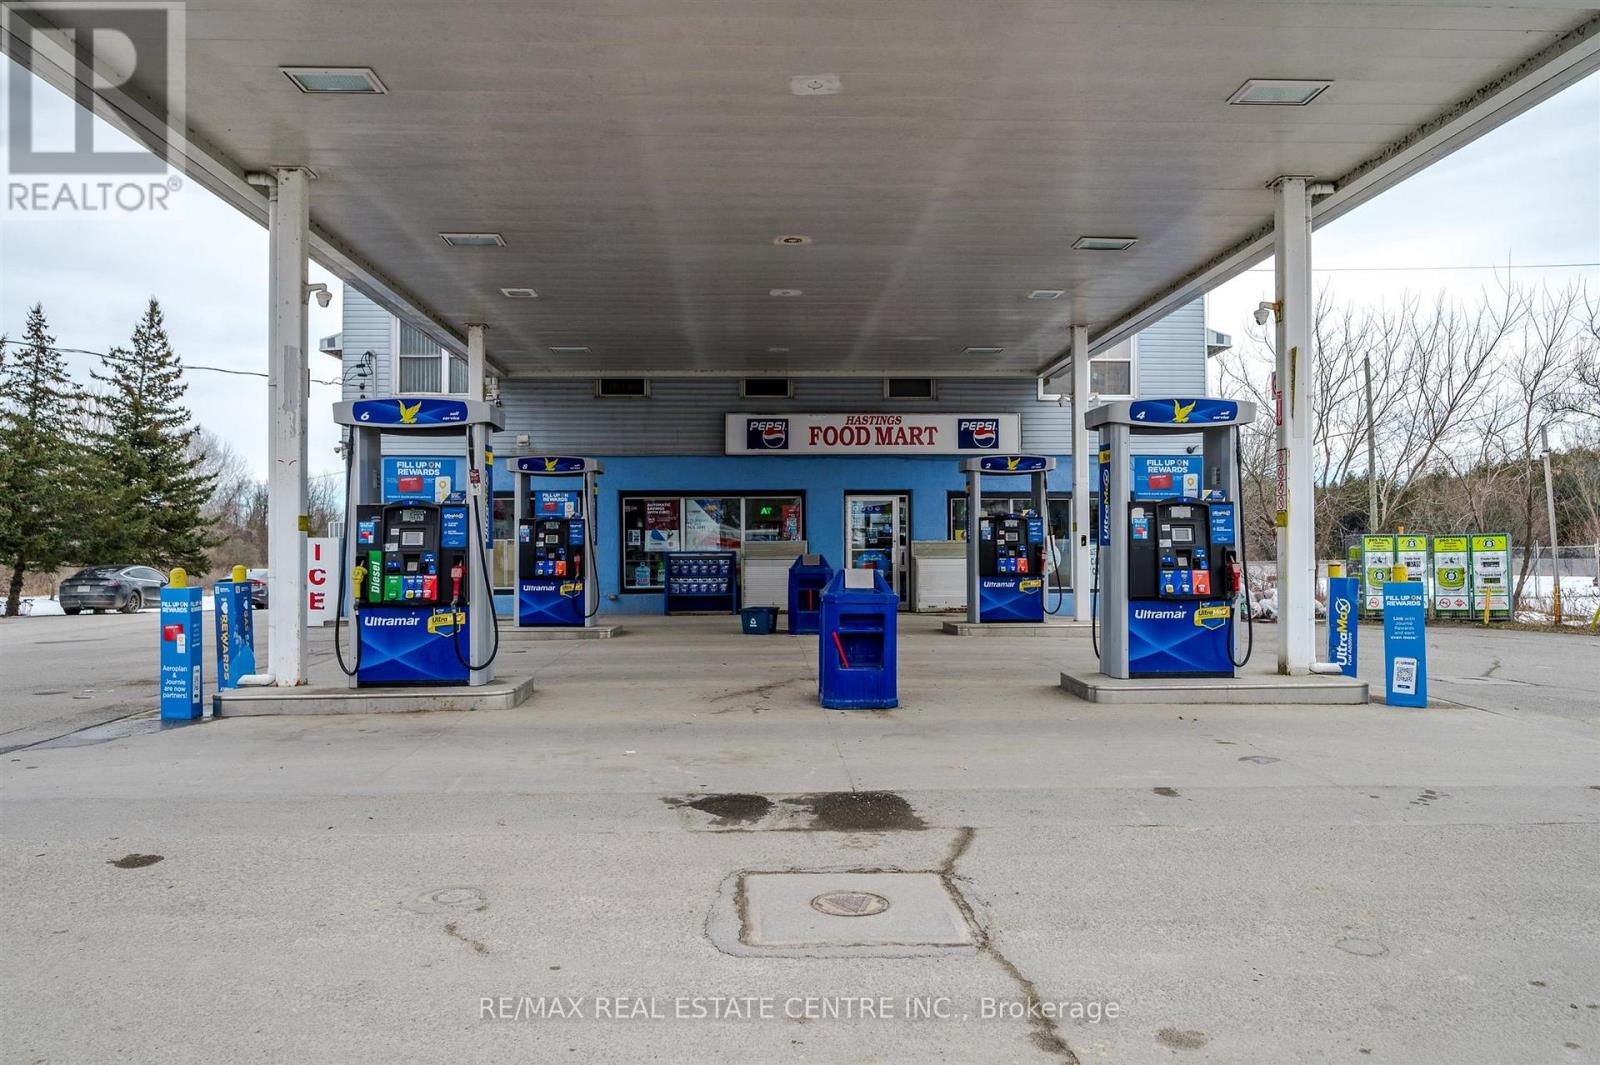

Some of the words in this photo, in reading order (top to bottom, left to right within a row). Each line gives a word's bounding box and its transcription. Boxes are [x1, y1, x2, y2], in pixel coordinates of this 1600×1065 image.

[360, 411, 370, 421] 6
[845, 415, 903, 426] HASTINGS
[1136, 411, 1146, 420] 4
[750, 421, 786, 431] PEPSI
[960, 421, 996, 431] PEPSI
[808, 426, 871, 446] FOOD
[875, 426, 938, 446] MART
[396, 461, 414, 469] FILL
[415, 461, 427, 469] UP
[428, 461, 441, 469] ON
[1146, 459, 1164, 467] FILL
[1164, 459, 1176, 467] UP
[1176, 459, 1189, 467] ON
[397, 468, 440, 476] REWARDS
[1147, 466, 1188, 474] REWARDS
[308, 543, 327, 611] ICE
[371, 561, 381, 593] Diesel
[1134, 608, 1187, 619] Ultramar
[364, 615, 421, 627] Ultramar
[221, 614, 230, 681] REWARDS
[162, 664, 188, 672] Aeroplan
